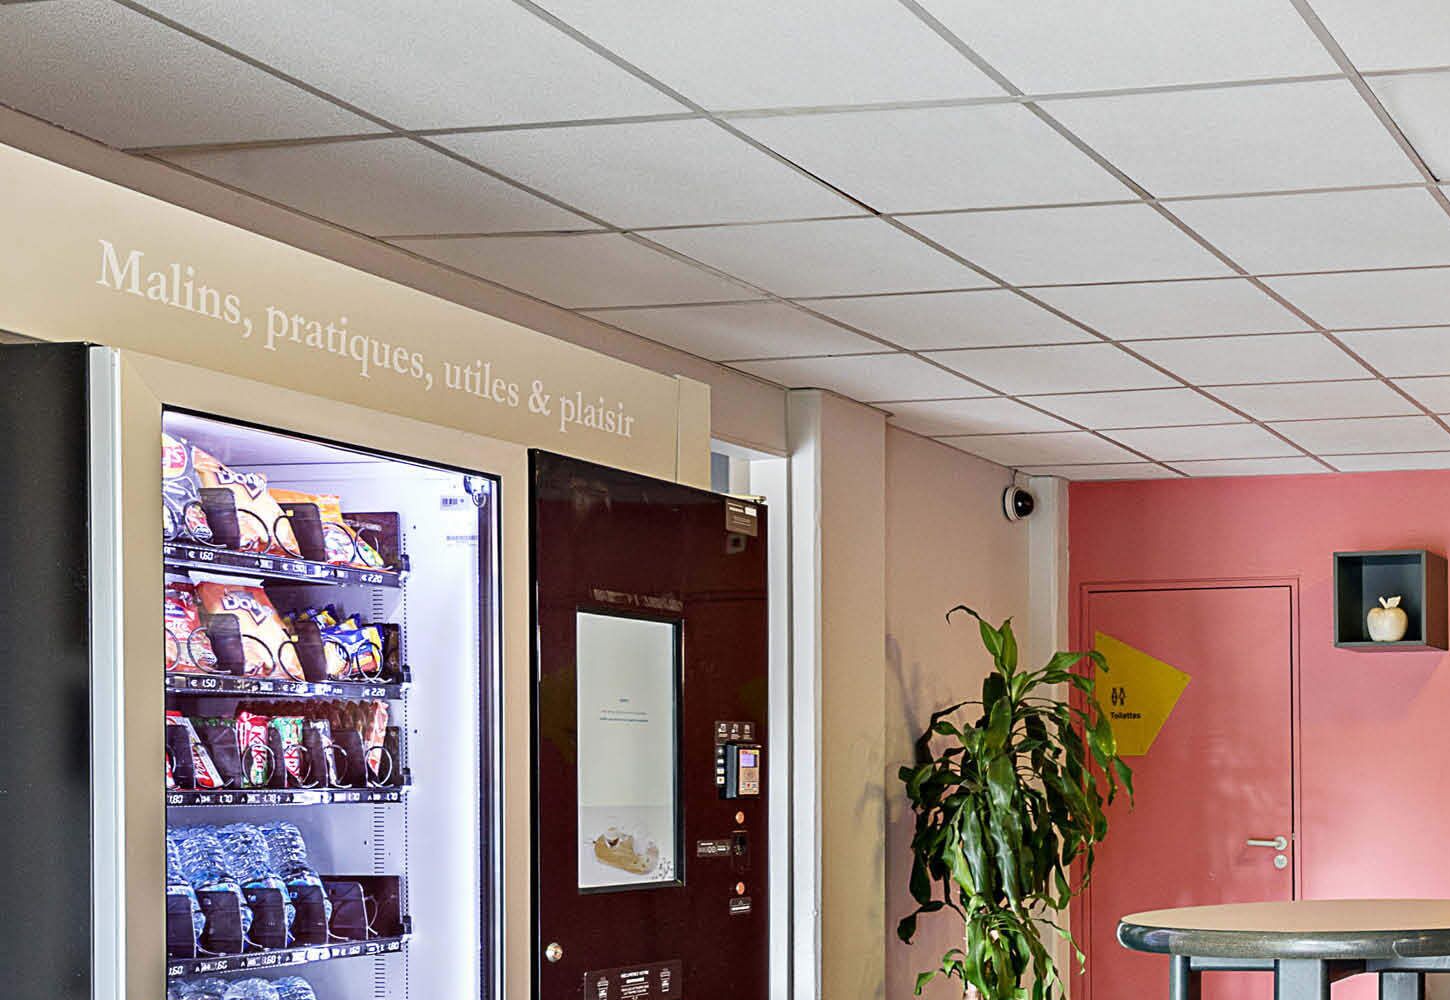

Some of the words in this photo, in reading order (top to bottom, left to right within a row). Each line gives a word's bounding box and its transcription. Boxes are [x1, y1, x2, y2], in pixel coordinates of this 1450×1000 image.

[96, 240, 253, 338] Malins,
[264, 305, 433, 391] pratiques,
[444, 359, 519, 407] utiles
[527, 380, 552, 416] &
[560, 392, 635, 438] plaisir
[1110, 711, 1141, 720] Toilettes
